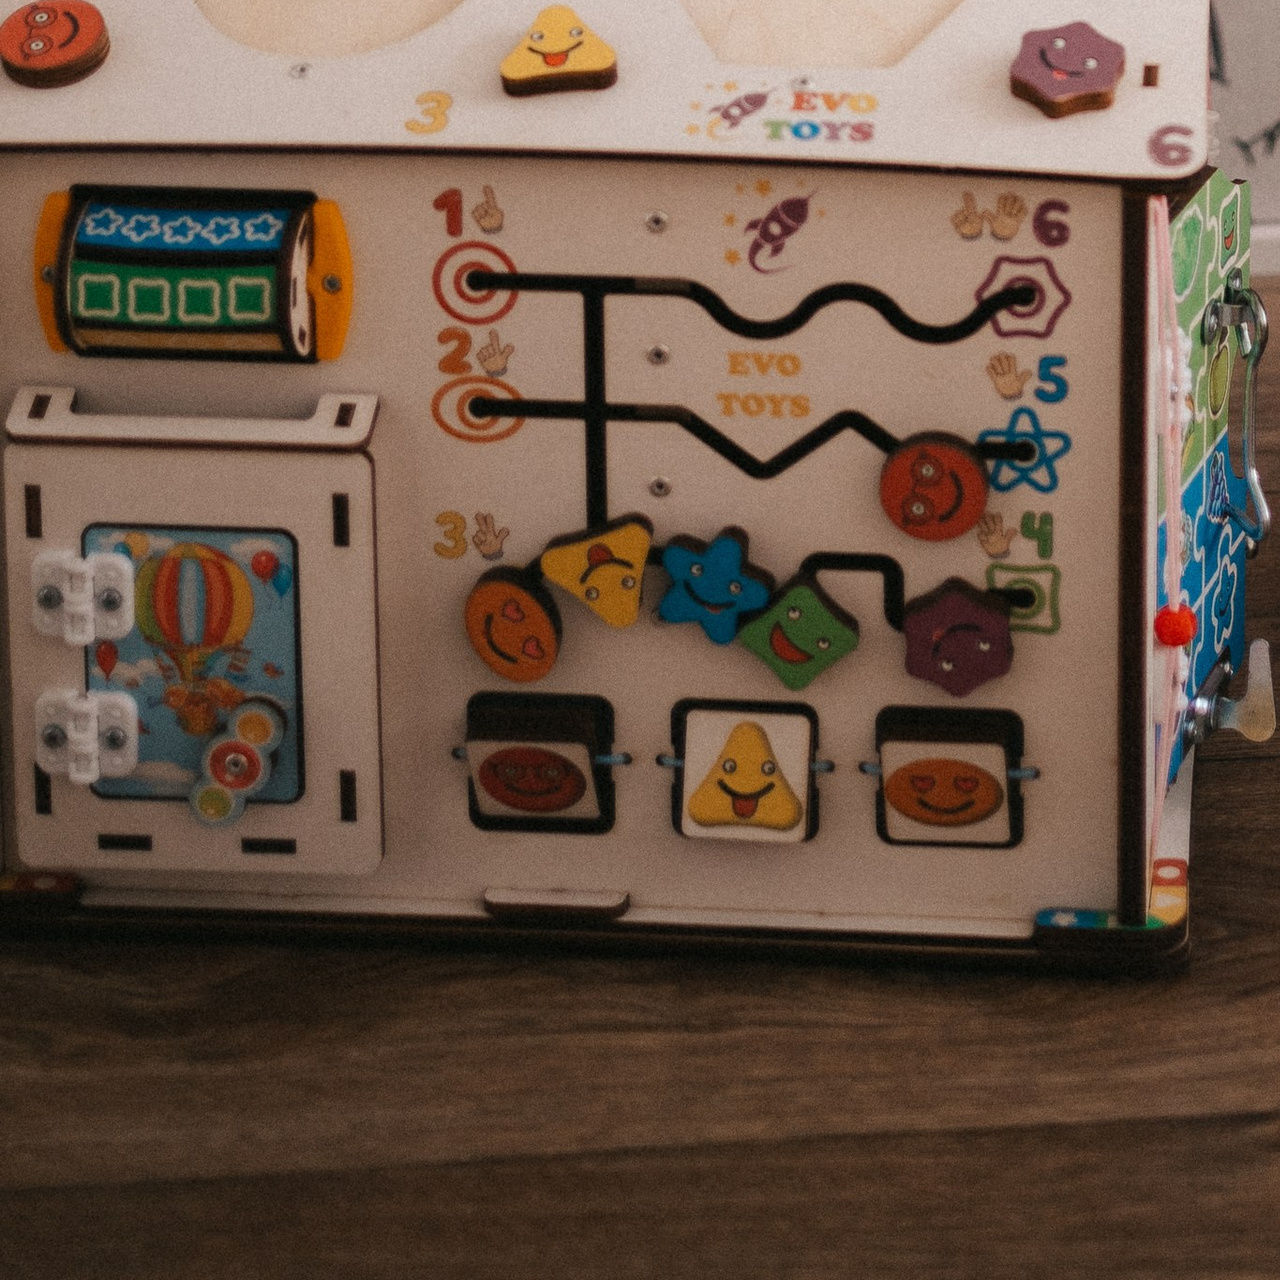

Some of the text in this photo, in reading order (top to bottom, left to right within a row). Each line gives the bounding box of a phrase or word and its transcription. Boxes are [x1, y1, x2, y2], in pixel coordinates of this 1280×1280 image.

[404, 91, 454, 134] 3
[790, 90, 879, 114] EVO
[764, 120, 875, 143] TOYS
[1147, 125, 1193, 167] 6
[433, 188, 463, 237] 1
[1032, 199, 1070, 247] 6
[437, 327, 472, 375] 2
[727, 351, 802, 377] EVO
[1034, 355, 1069, 403] 5
[716, 393, 811, 418] TOYS
[433, 511, 467, 559] 3
[1021, 510, 1053, 559] 4
